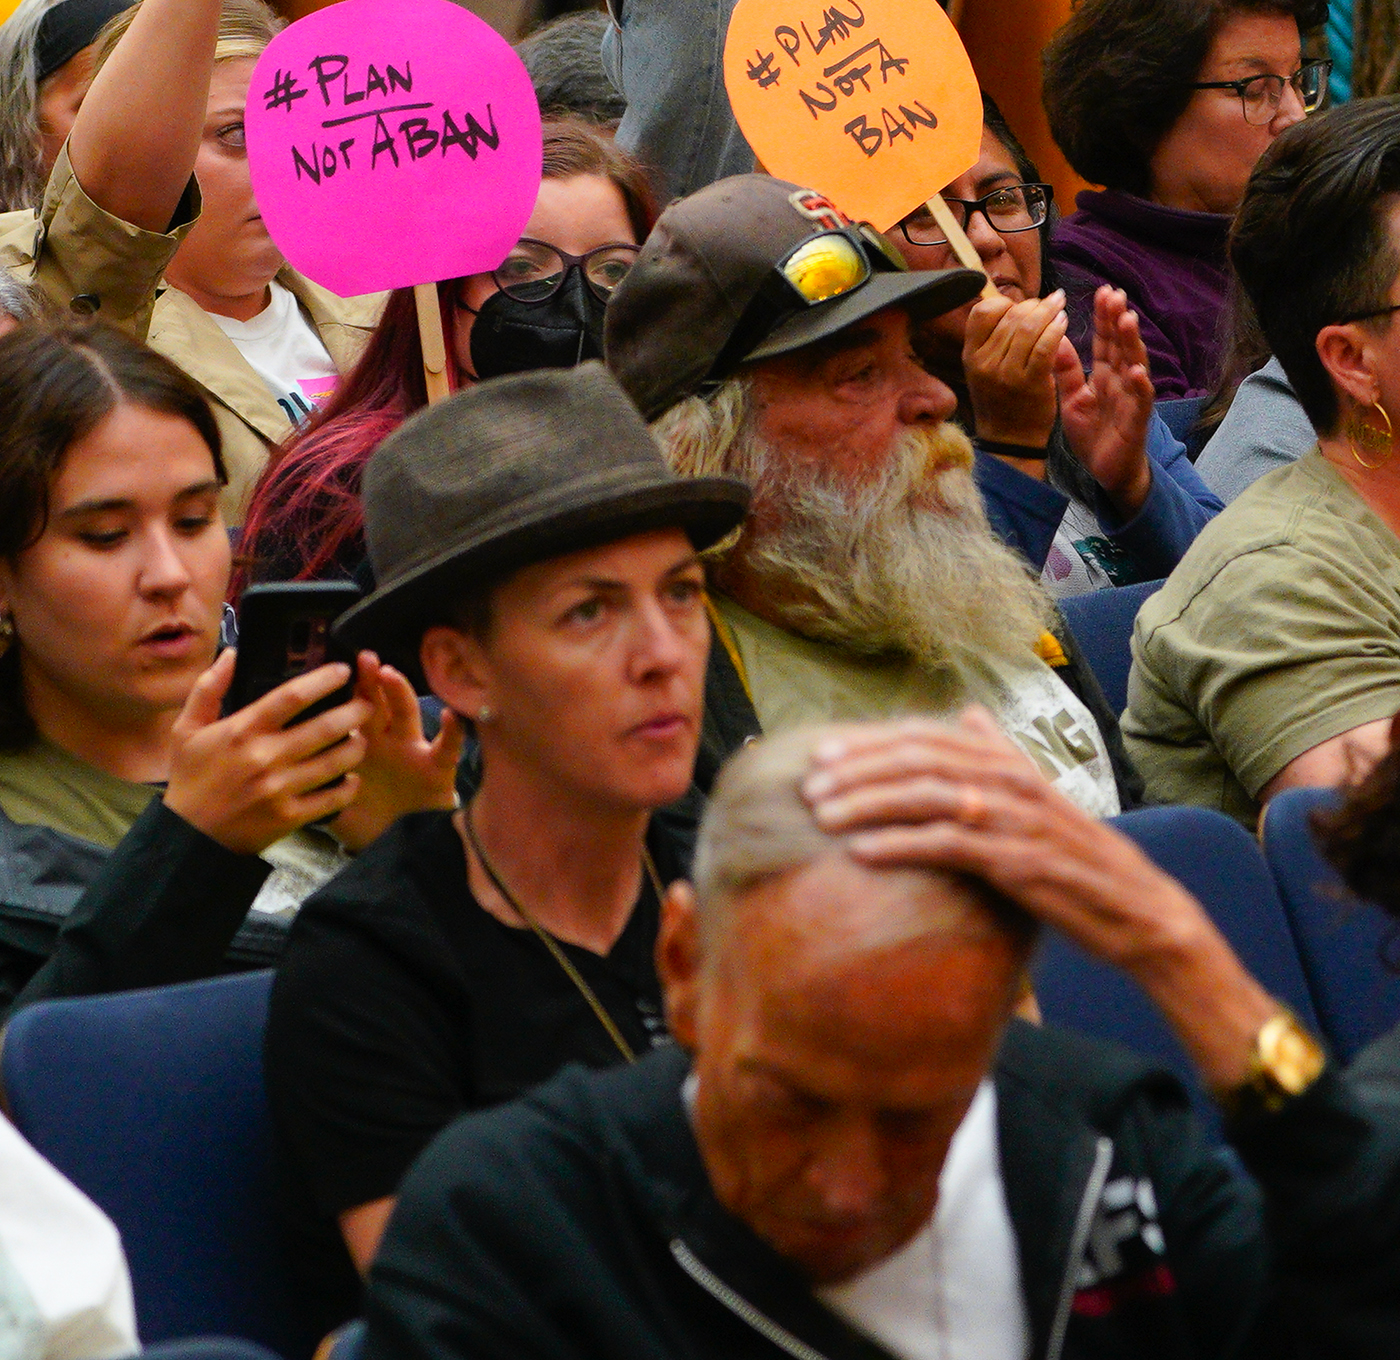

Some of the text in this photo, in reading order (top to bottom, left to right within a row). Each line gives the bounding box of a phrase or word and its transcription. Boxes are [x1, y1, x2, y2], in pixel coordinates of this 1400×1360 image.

[263, 54, 413, 113] #PLAN
[799, 42, 910, 120] NOT A
[844, 100, 938, 158] BAN
[291, 138, 355, 186] NOT
